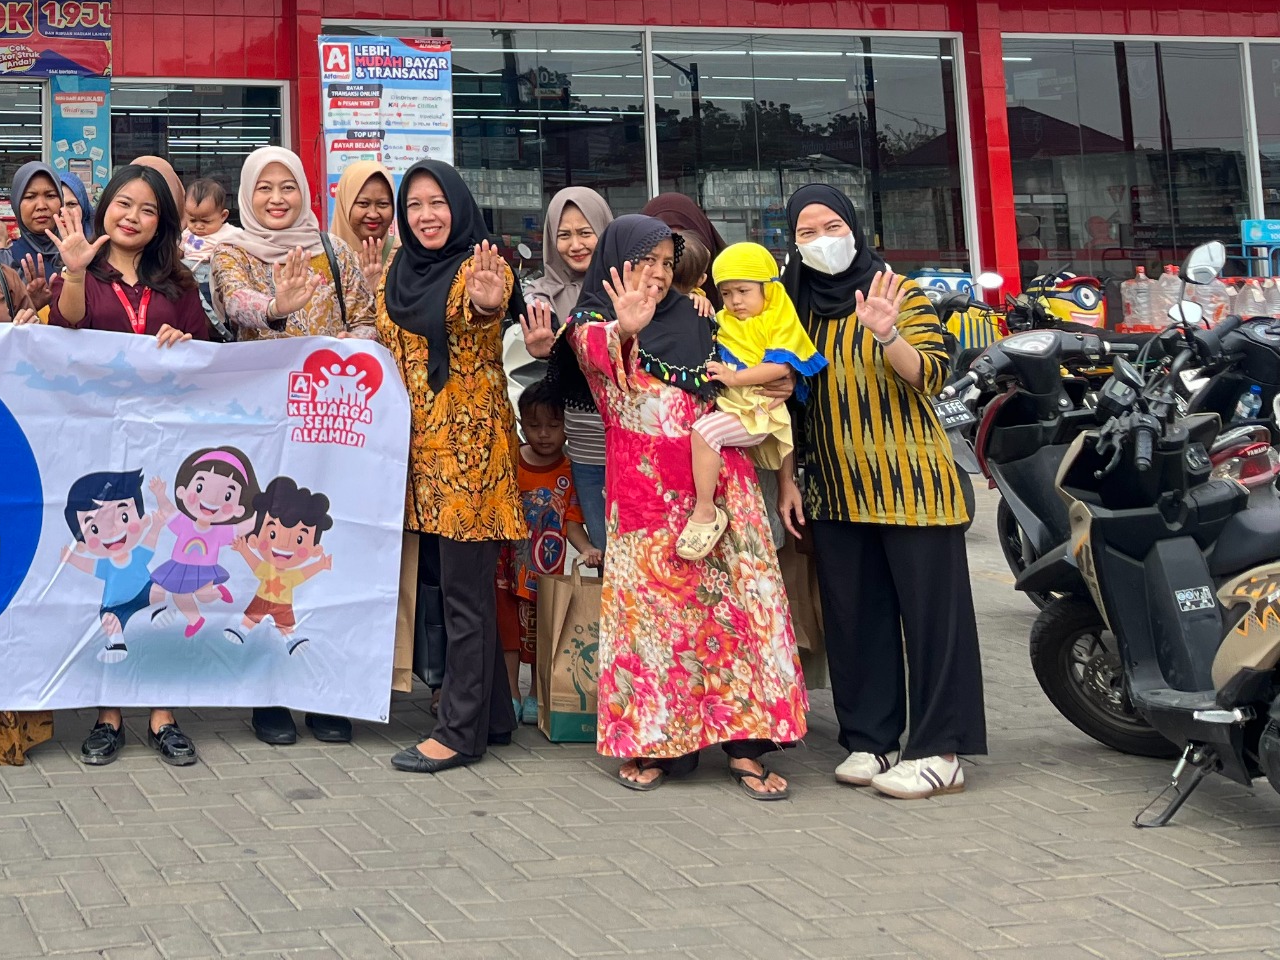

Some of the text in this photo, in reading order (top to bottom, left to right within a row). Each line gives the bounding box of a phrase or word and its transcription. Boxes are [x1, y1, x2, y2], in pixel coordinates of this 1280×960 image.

[41, 1, 111, 28] 1,9Jt
[354, 45, 390, 56] LEBIH
[6, 59, 32, 69] Anda!
[355, 56, 448, 68] MUDAH BAYAR
[356, 68, 438, 79] & TRANSAKSI
[288, 402, 372, 423] KELUARGA
[305, 416, 354, 431] SEHAT
[292, 428, 364, 447] ALFAMIDI
[1247, 446, 1267, 456] YAMAHA
